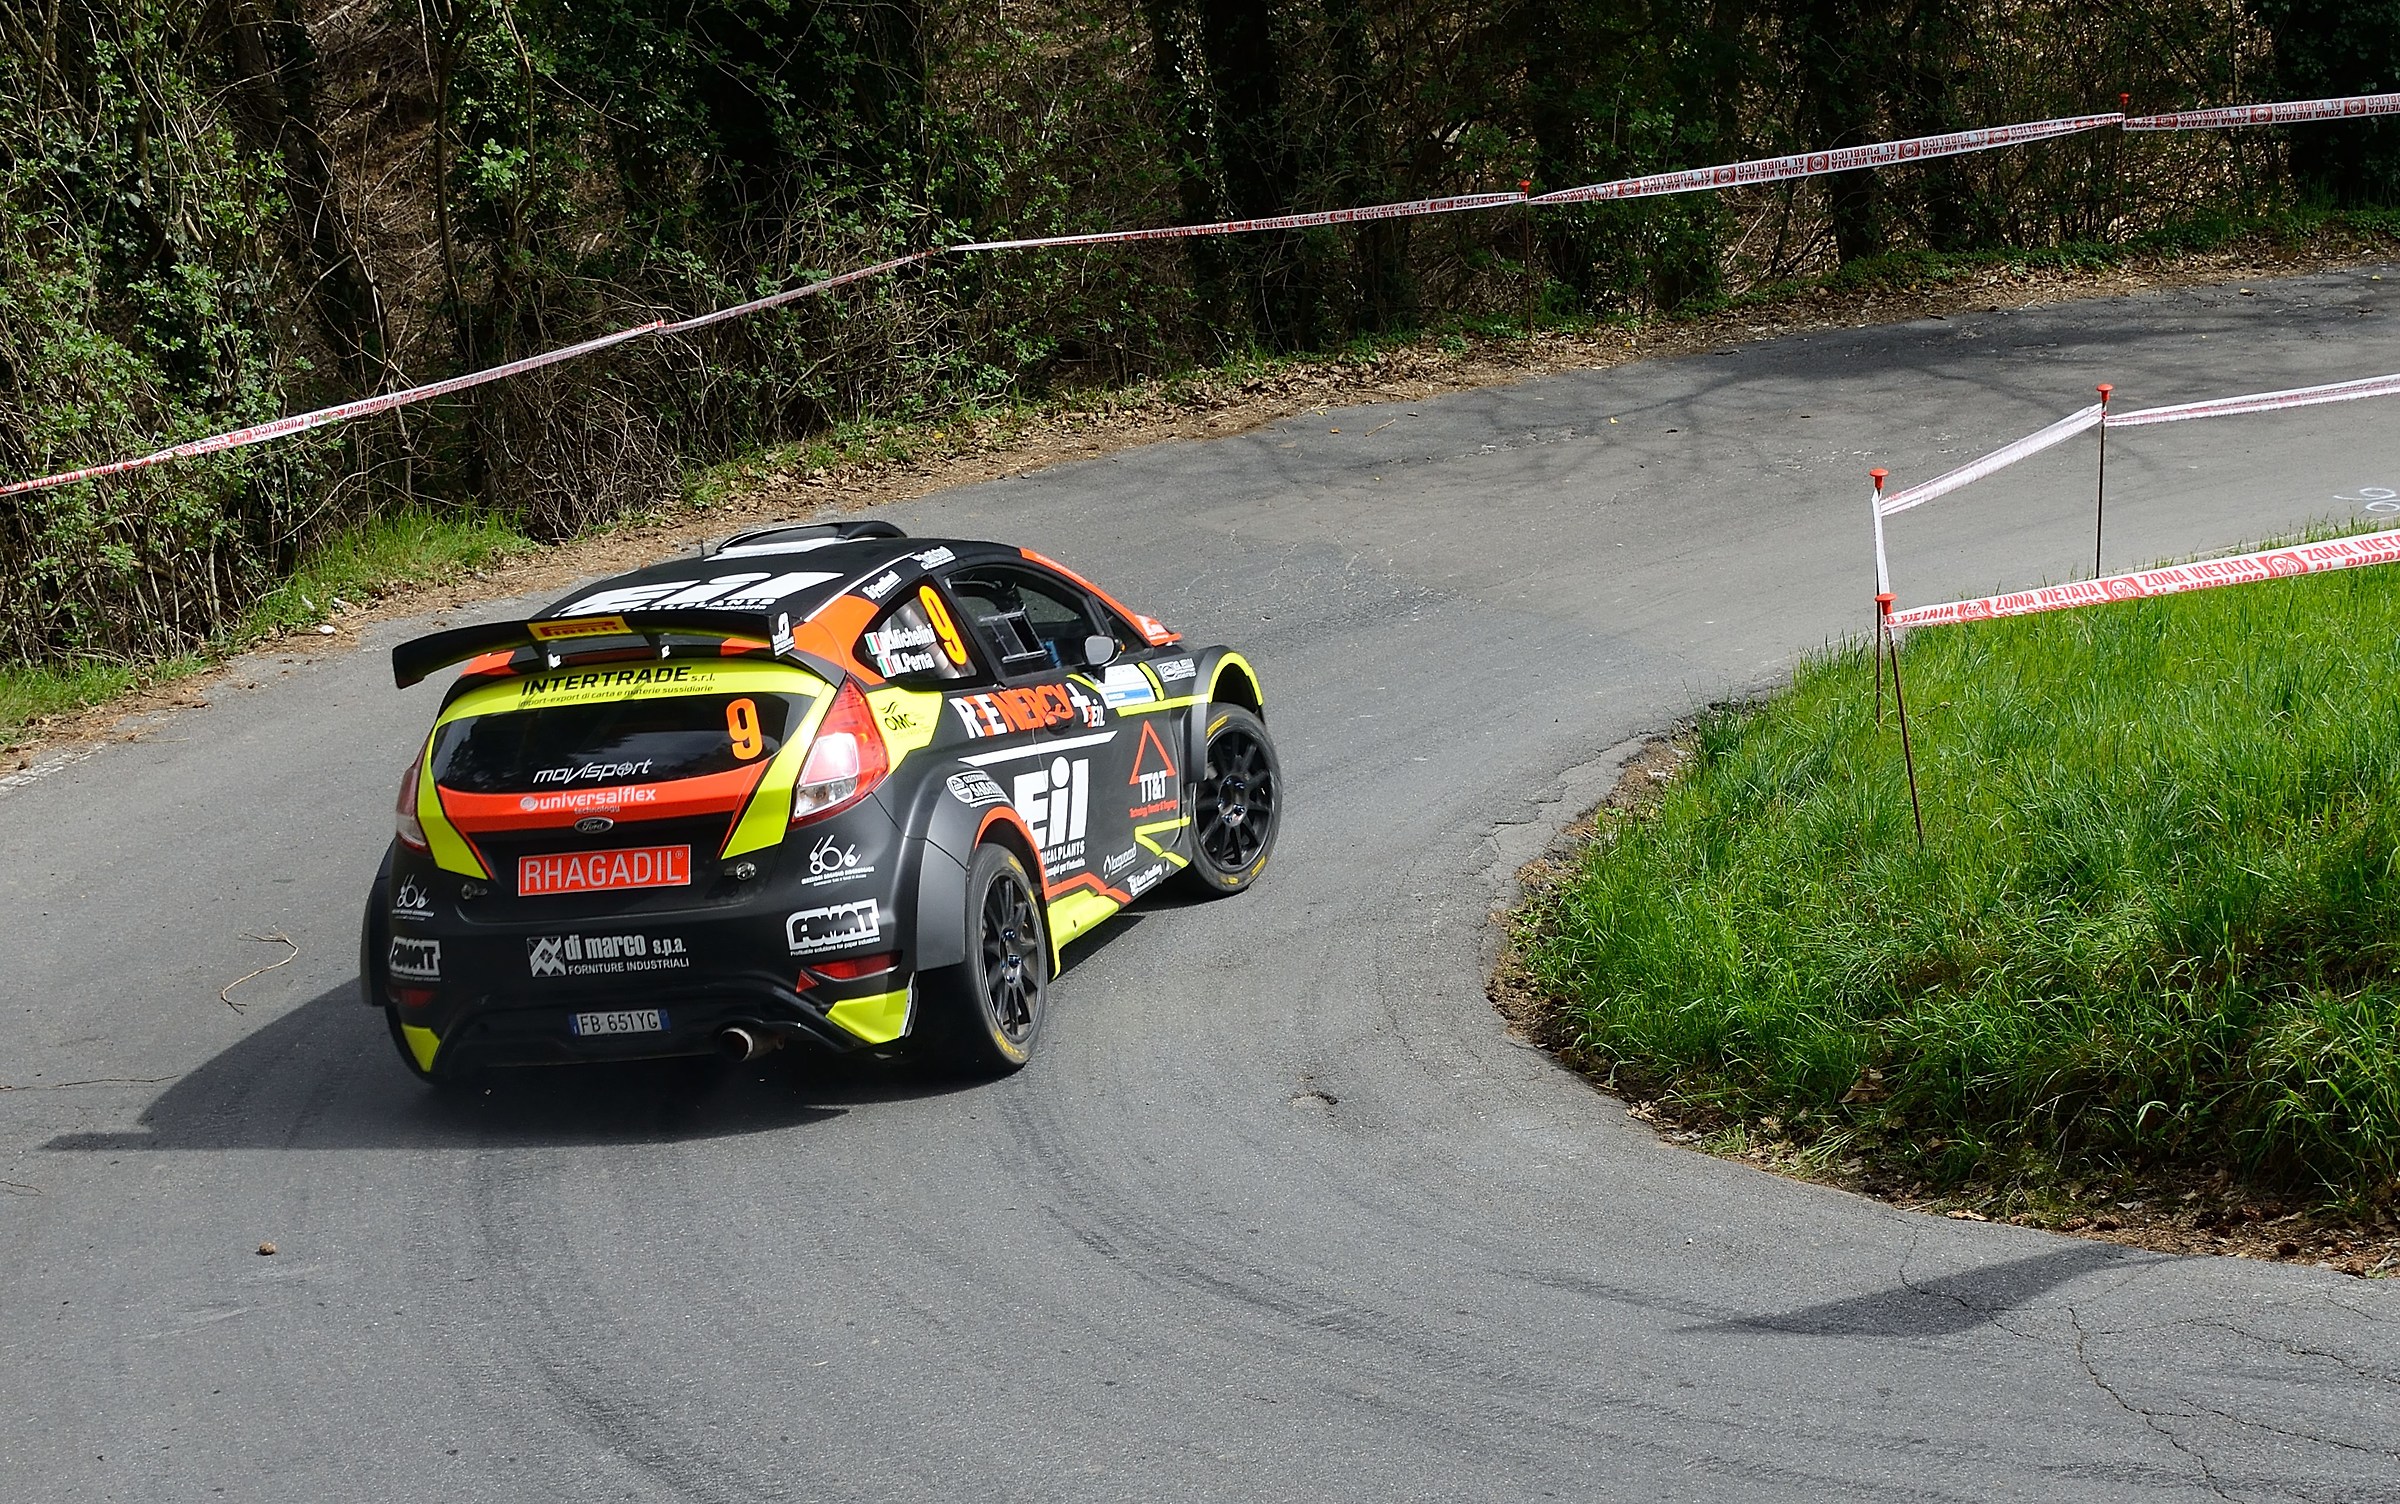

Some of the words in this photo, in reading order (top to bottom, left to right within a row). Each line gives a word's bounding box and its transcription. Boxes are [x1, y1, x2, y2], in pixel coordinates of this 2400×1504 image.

[2274, 102, 2324, 113] PUBBLICO
[2328, 100, 2341, 109] AL
[2219, 116, 2249, 126] ZONA
[2274, 112, 2312, 122] VIETATA
[2313, 110, 2341, 120] ZONA
[2179, 118, 2218, 128] VIETATA
[1922, 134, 1970, 147] PUBBLICO
[1974, 132, 1986, 141] AL
[1883, 144, 1896, 152] AL
[1922, 143, 1958, 156] VIETATA
[1961, 140, 1985, 149] ZONA
[1831, 146, 1880, 160] PUBBLICO
[1870, 153, 1896, 163] ZONA
[1739, 159, 1787, 174] PUBBLICO
[1790, 157, 1804, 166] AL
[1831, 156, 1867, 169] VIETATA
[1697, 170, 1711, 179] AL
[1738, 169, 1776, 182] VIETATA
[1778, 166, 1804, 175] ZONA
[1643, 173, 1693, 187] PUBBLICO
[1684, 180, 1710, 188] ZONA
[2301, 543, 2359, 562] ZONA
[2138, 570, 2188, 588] ZONA
[2187, 558, 2261, 579] VIETATA
[1995, 593, 2037, 610] ZONA
[2037, 582, 2100, 602] VIETATA
[918, 584, 968, 666] 9
[521, 665, 693, 697] INTERTRADE
[690, 672, 716, 682] s.r.l.
[591, 691, 616, 699] carta
[661, 684, 714, 694] sussidiarie
[884, 713, 917, 731] OMC
[727, 697, 763, 761] 9
[539, 786, 657, 811] universalflex
[573, 805, 621, 815] technology
[564, 935, 583, 961] di
[584, 934, 647, 960] marco
[652, 938, 687, 957] s.p.a.
[567, 961, 625, 976] FORNITURE
[626, 957, 690, 972] INDUSTRIALI
[580, 1015, 600, 1035] FB
